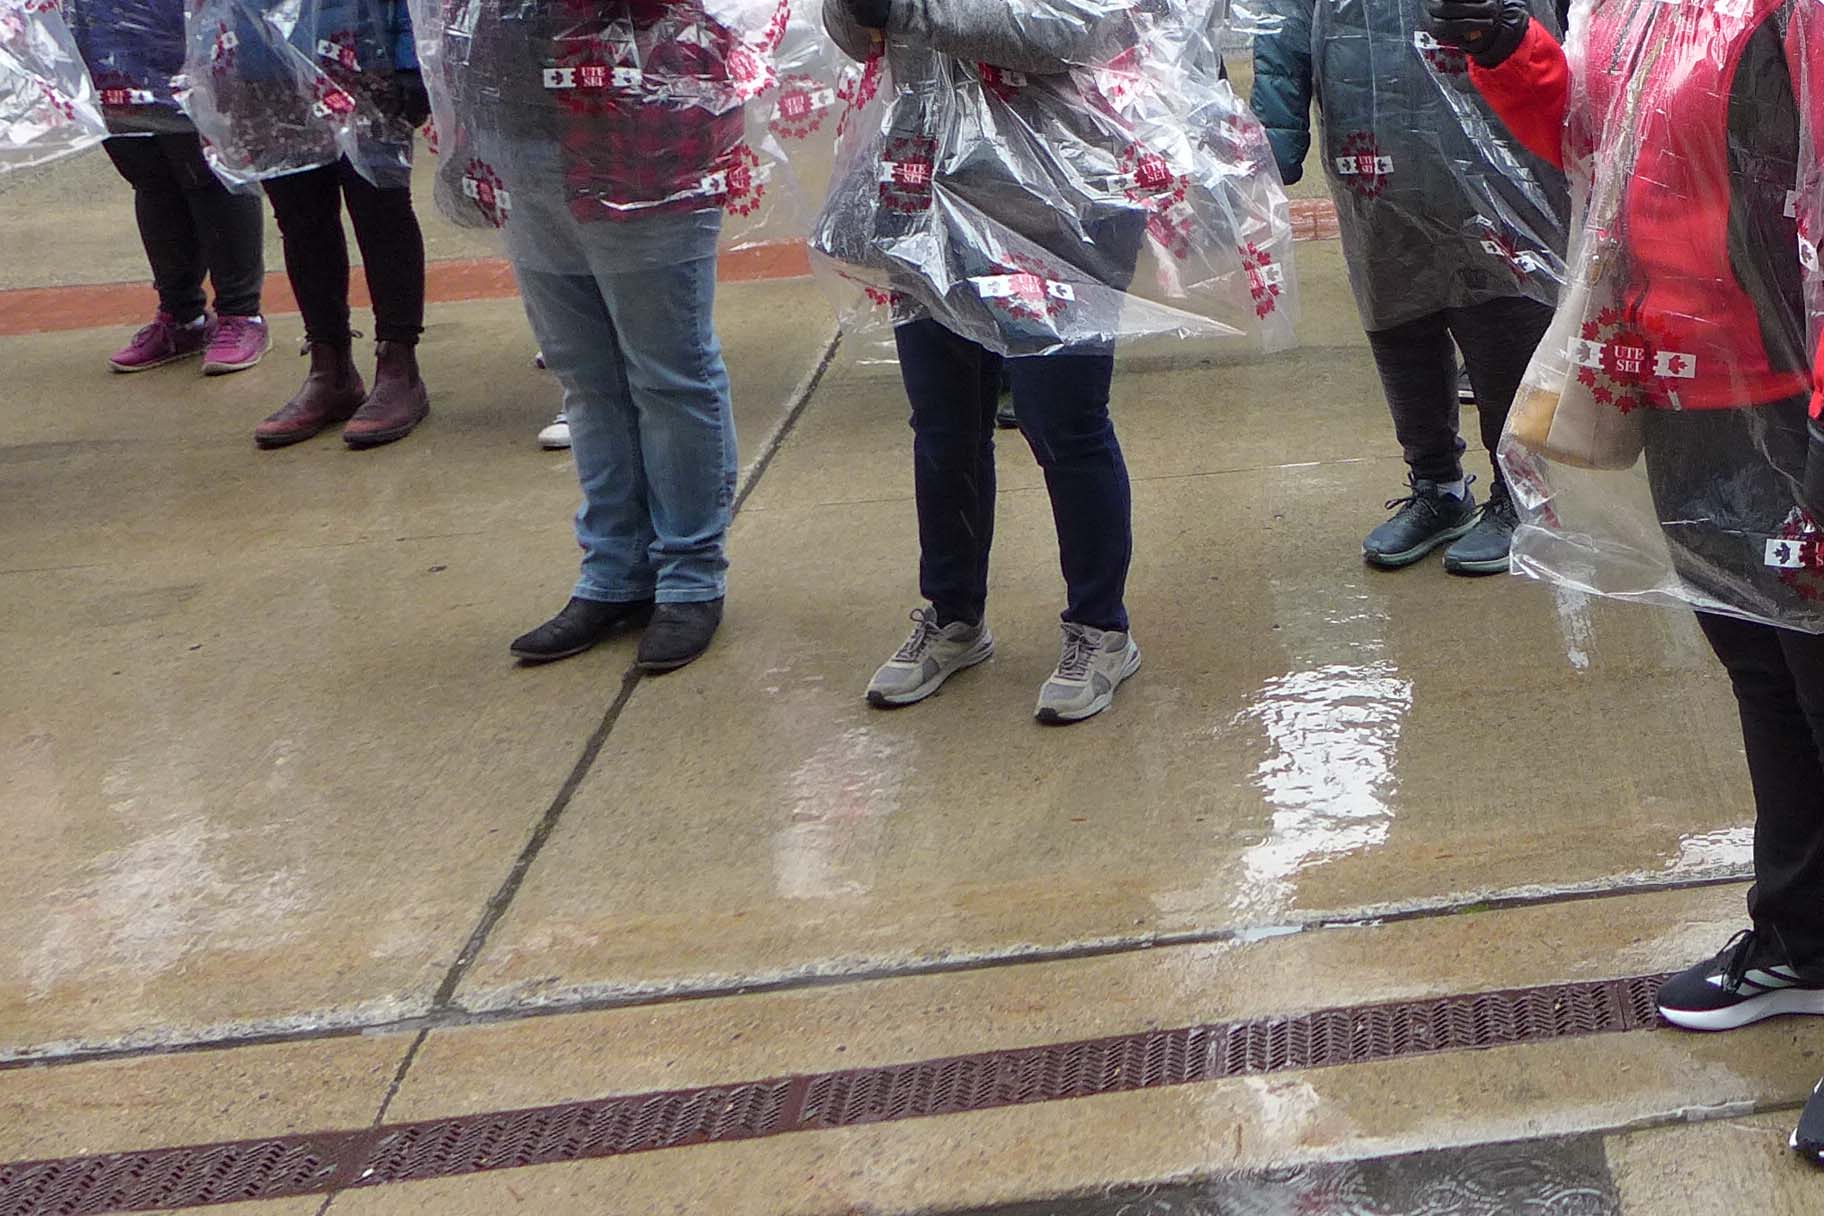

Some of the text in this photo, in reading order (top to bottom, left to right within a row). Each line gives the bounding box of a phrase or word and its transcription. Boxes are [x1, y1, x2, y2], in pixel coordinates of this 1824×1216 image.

[581, 66, 606, 77] UTE
[583, 76, 603, 87] SEI
[903, 163, 927, 174] UTE
[1147, 169, 1167, 182] SEI
[1614, 345, 1645, 361] UTE
[1616, 359, 1641, 373] SEI
